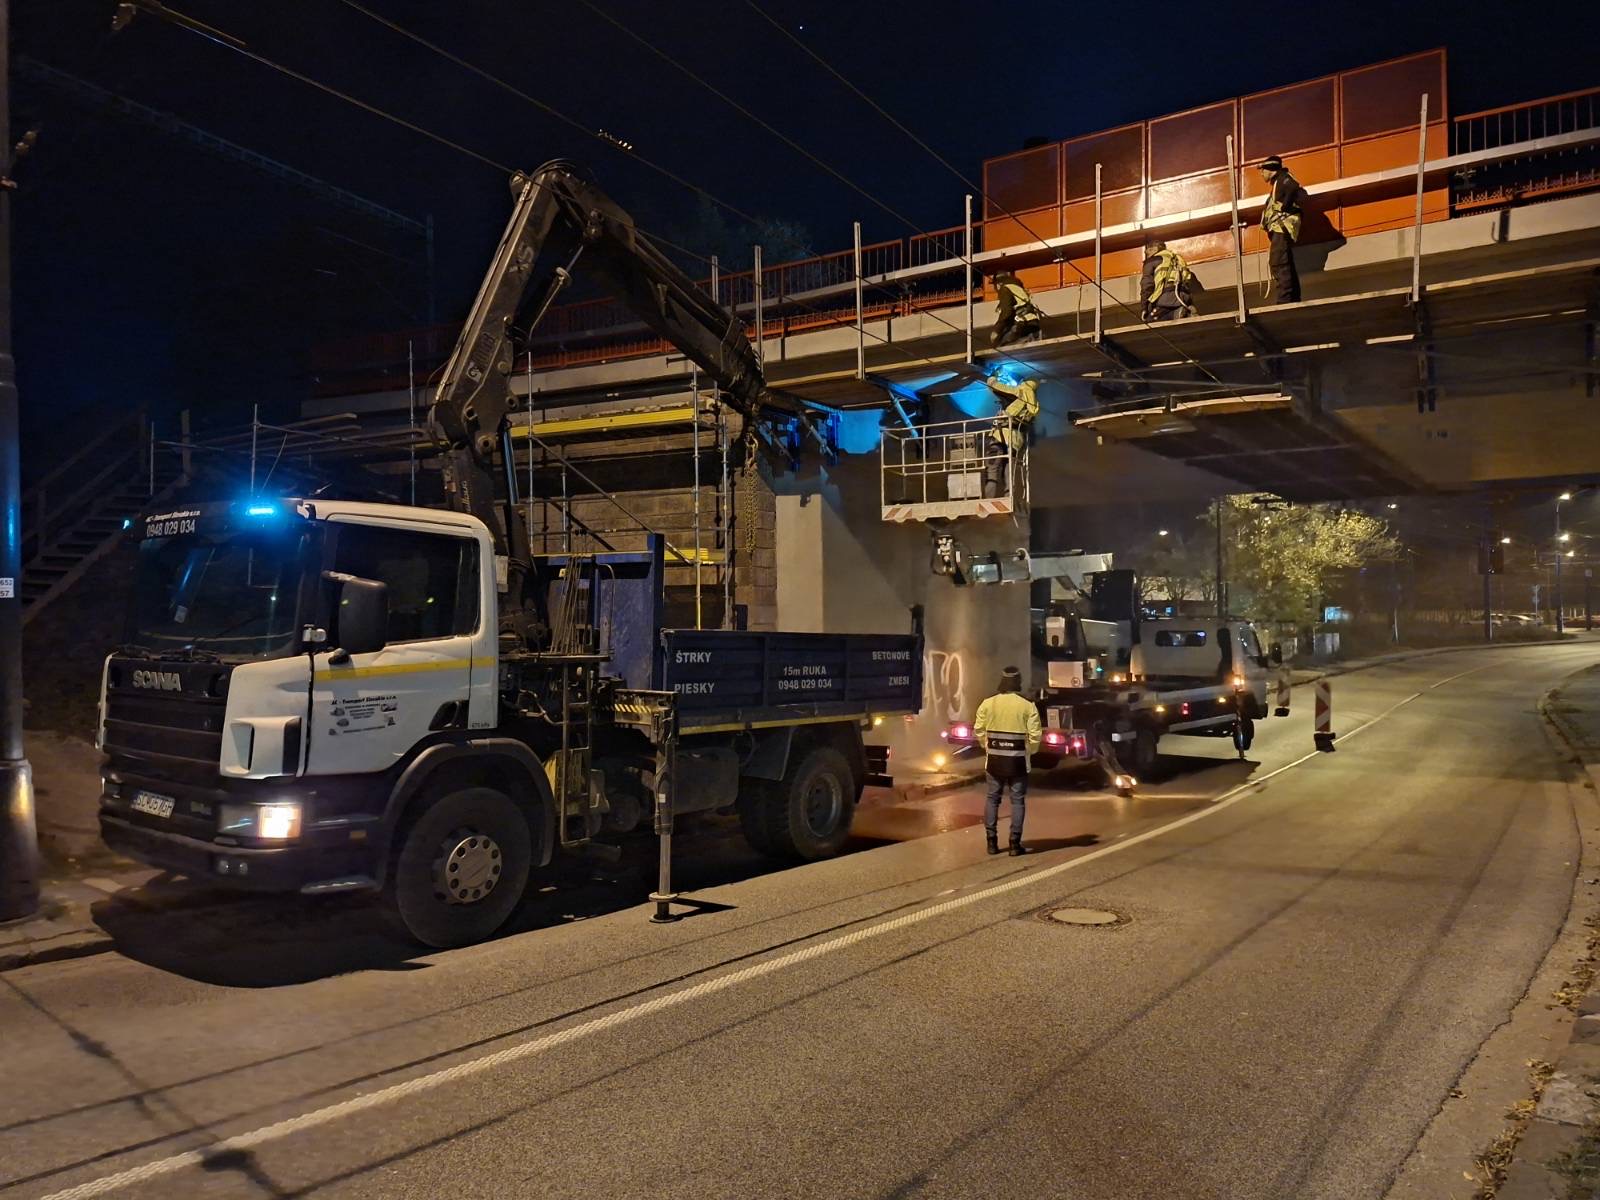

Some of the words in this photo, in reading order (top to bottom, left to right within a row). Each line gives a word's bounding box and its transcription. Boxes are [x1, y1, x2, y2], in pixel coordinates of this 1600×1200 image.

[146, 522, 163, 537] 0948
[164, 520, 179, 535] 029
[180, 519, 196, 534] 034
[783, 667, 801, 676] 15m
[802, 665, 827, 675] RUKA
[132, 670, 182, 691] SCANIA
[778, 680, 799, 690] 0948
[801, 679, 816, 689] 029
[818, 679, 832, 688] 034
[888, 676, 910, 686] ZMESI
[674, 682, 715, 694] PIESKY
